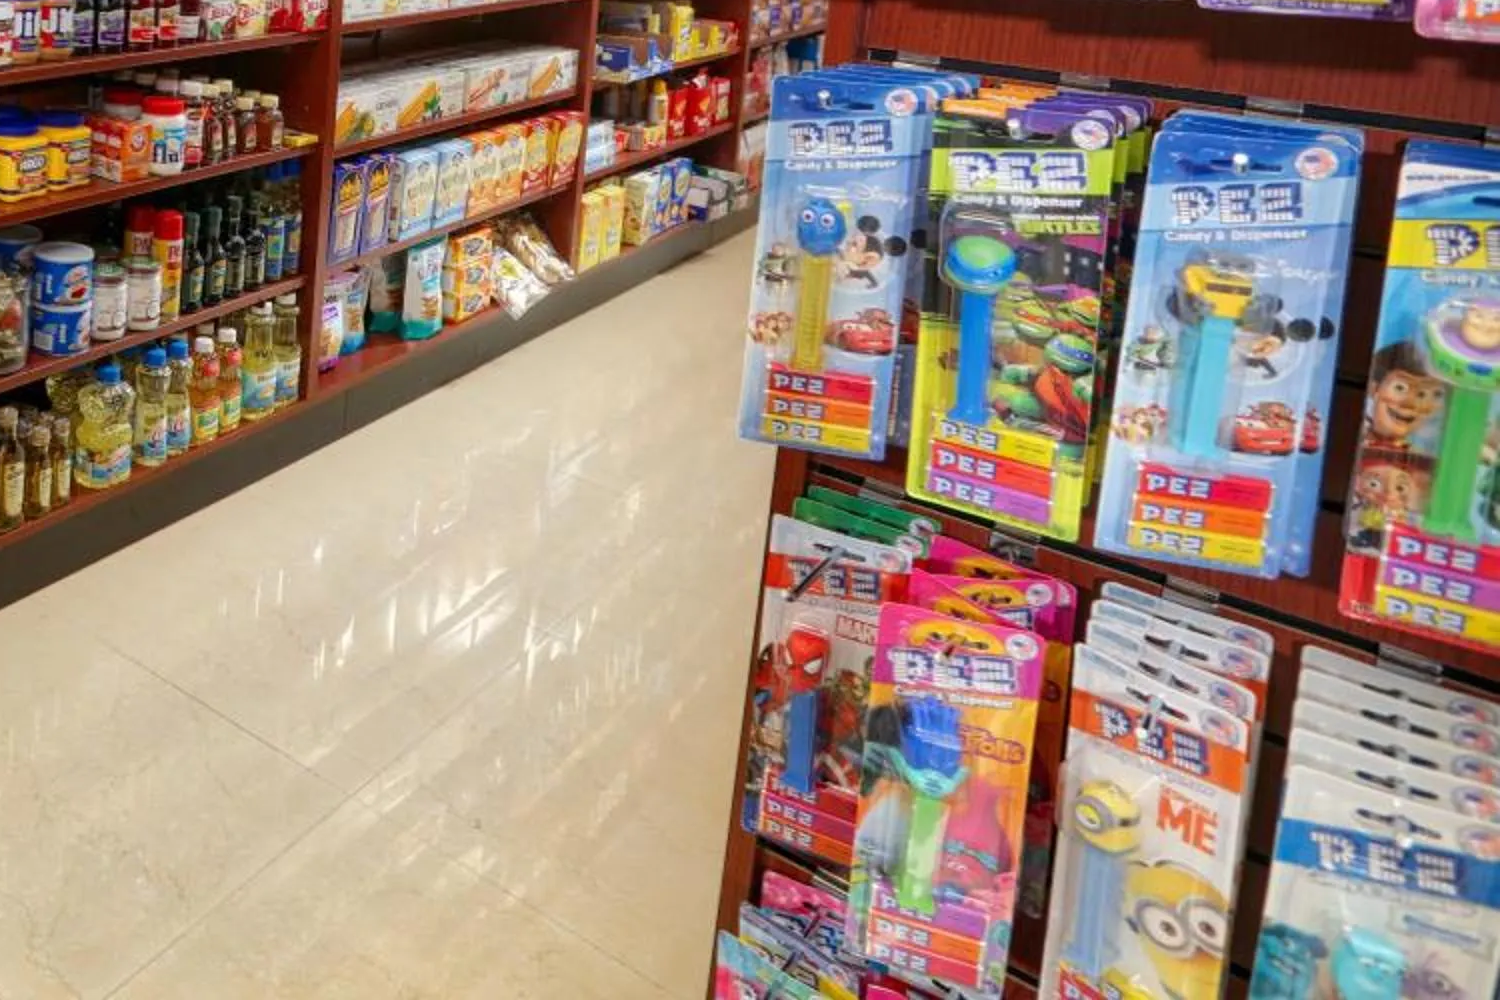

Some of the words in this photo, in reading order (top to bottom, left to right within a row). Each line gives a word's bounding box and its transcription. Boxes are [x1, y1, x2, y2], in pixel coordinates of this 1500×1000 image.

[788, 120, 893, 157] PEZ
[949, 151, 1088, 193] PEZ
[1171, 182, 1303, 226] PEZ
[1164, 231, 1213, 244] Candy
[1231, 229, 1308, 241] Dispenser
[774, 373, 825, 395] PEZ
[772, 399, 825, 420] PEZ
[771, 421, 822, 442] PEZ
[940, 419, 998, 450] PEZ
[937, 450, 997, 477] PEZ
[934, 477, 995, 506] PEZ
[1146, 474, 1210, 500] PEZ
[1141, 503, 1206, 529] PEZ
[1139, 529, 1205, 555] PEZ
[1397, 534, 1478, 572] PEZ
[1391, 563, 1475, 602] PEZ
[1384, 596, 1468, 634] PEZ
[767, 800, 814, 826] PEZ
[1156, 793, 1219, 857] ME
[765, 822, 813, 849] PEZ
[1309, 825, 1467, 897] PEZ
[877, 917, 931, 944] PEZ
[874, 943, 928, 971] PEZ
